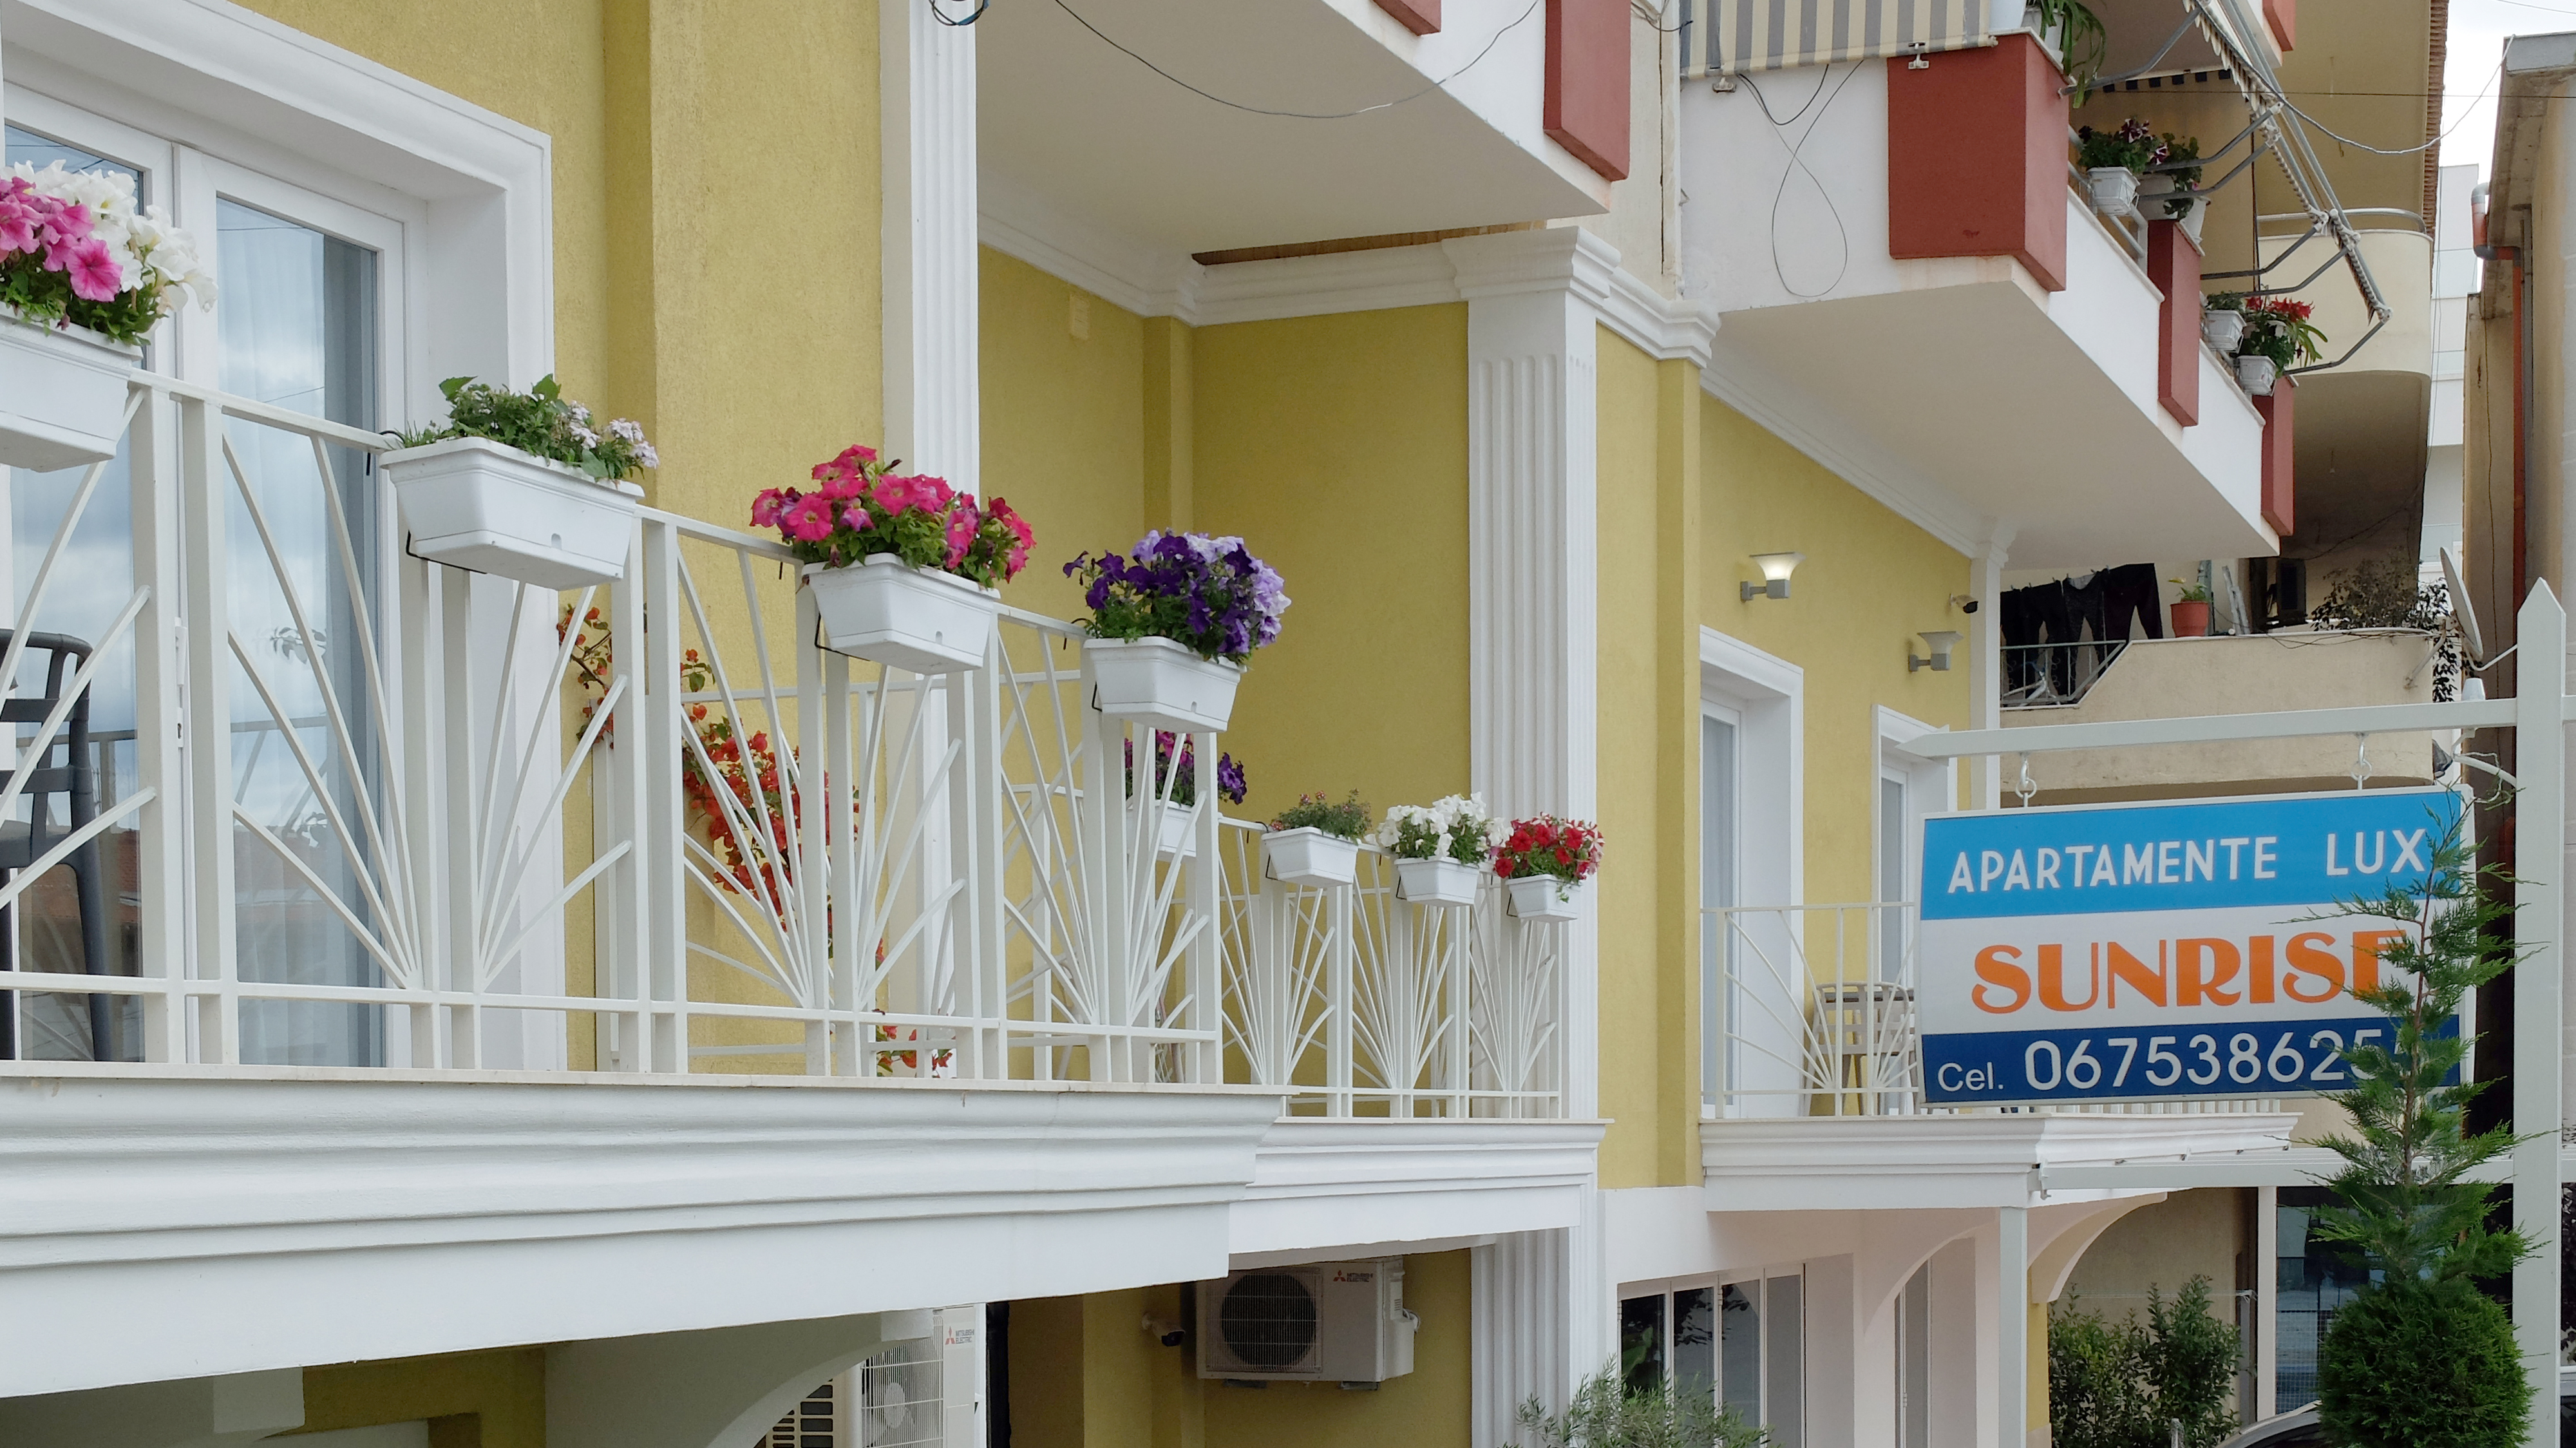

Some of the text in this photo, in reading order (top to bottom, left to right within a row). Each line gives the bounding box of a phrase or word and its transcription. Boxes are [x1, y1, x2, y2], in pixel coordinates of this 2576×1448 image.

[1947, 828, 2427, 893] APARTAMENTE LUX
[1971, 929, 2409, 1014] SUNRISE
[1937, 1062, 2003, 1092] Cel.
